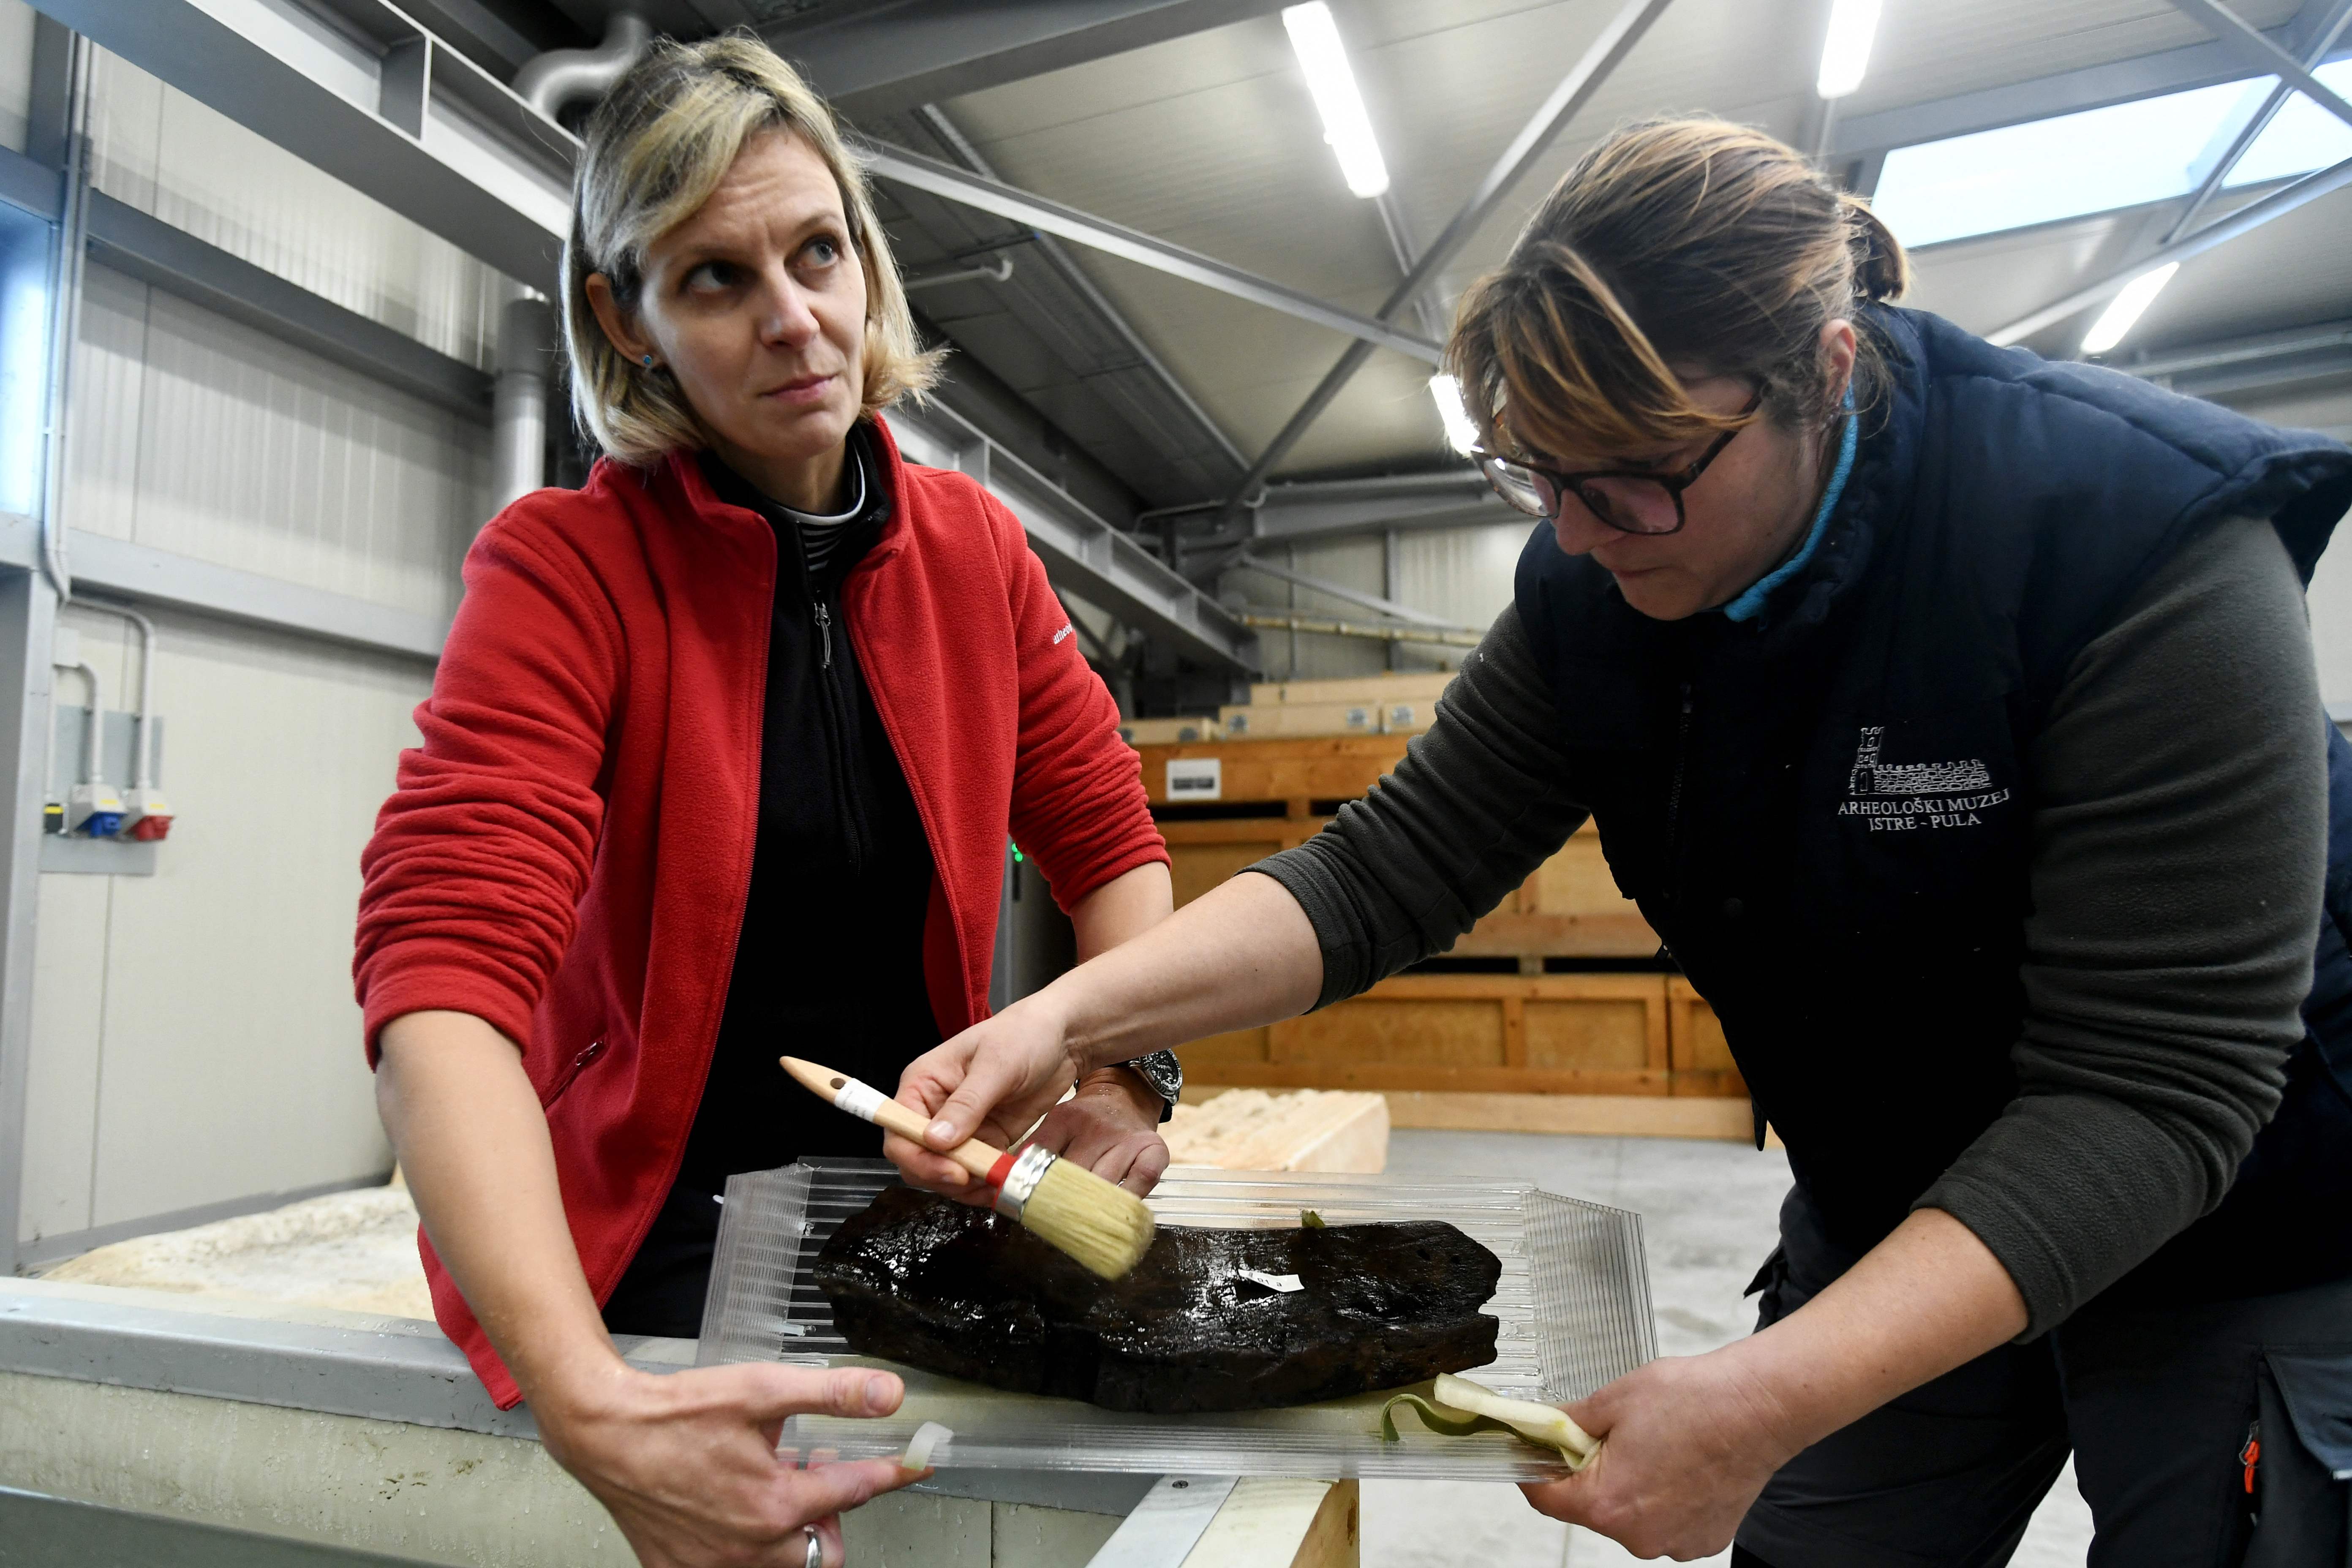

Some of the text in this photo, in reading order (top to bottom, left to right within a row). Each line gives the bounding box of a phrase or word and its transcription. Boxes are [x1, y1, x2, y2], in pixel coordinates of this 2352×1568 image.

[1838, 789, 2009, 814] ARHEOLOŠKI MUZEJ
[1867, 817, 1917, 831] ISTRE
[1930, 813, 1981, 828] PULA
